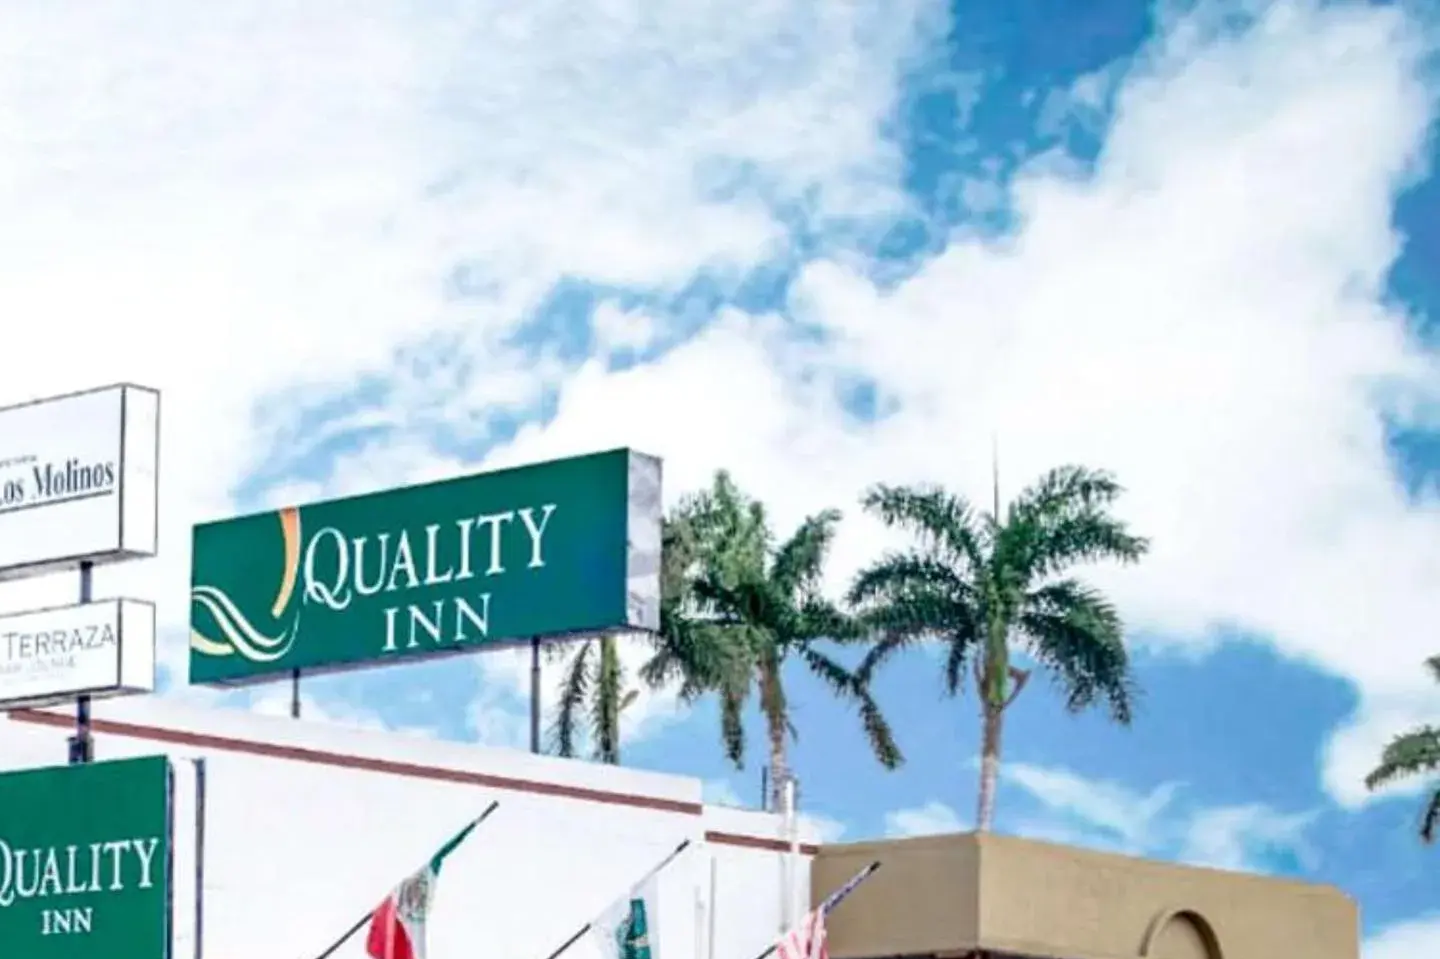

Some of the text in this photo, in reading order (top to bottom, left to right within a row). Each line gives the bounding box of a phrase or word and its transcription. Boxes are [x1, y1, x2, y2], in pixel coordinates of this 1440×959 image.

[32, 458, 114, 500] Molinos
[303, 504, 556, 610] QUALITY
[2, 624, 116, 661] TERRAZA
[383, 594, 492, 652] INN
[42, 908, 93, 935] INN
